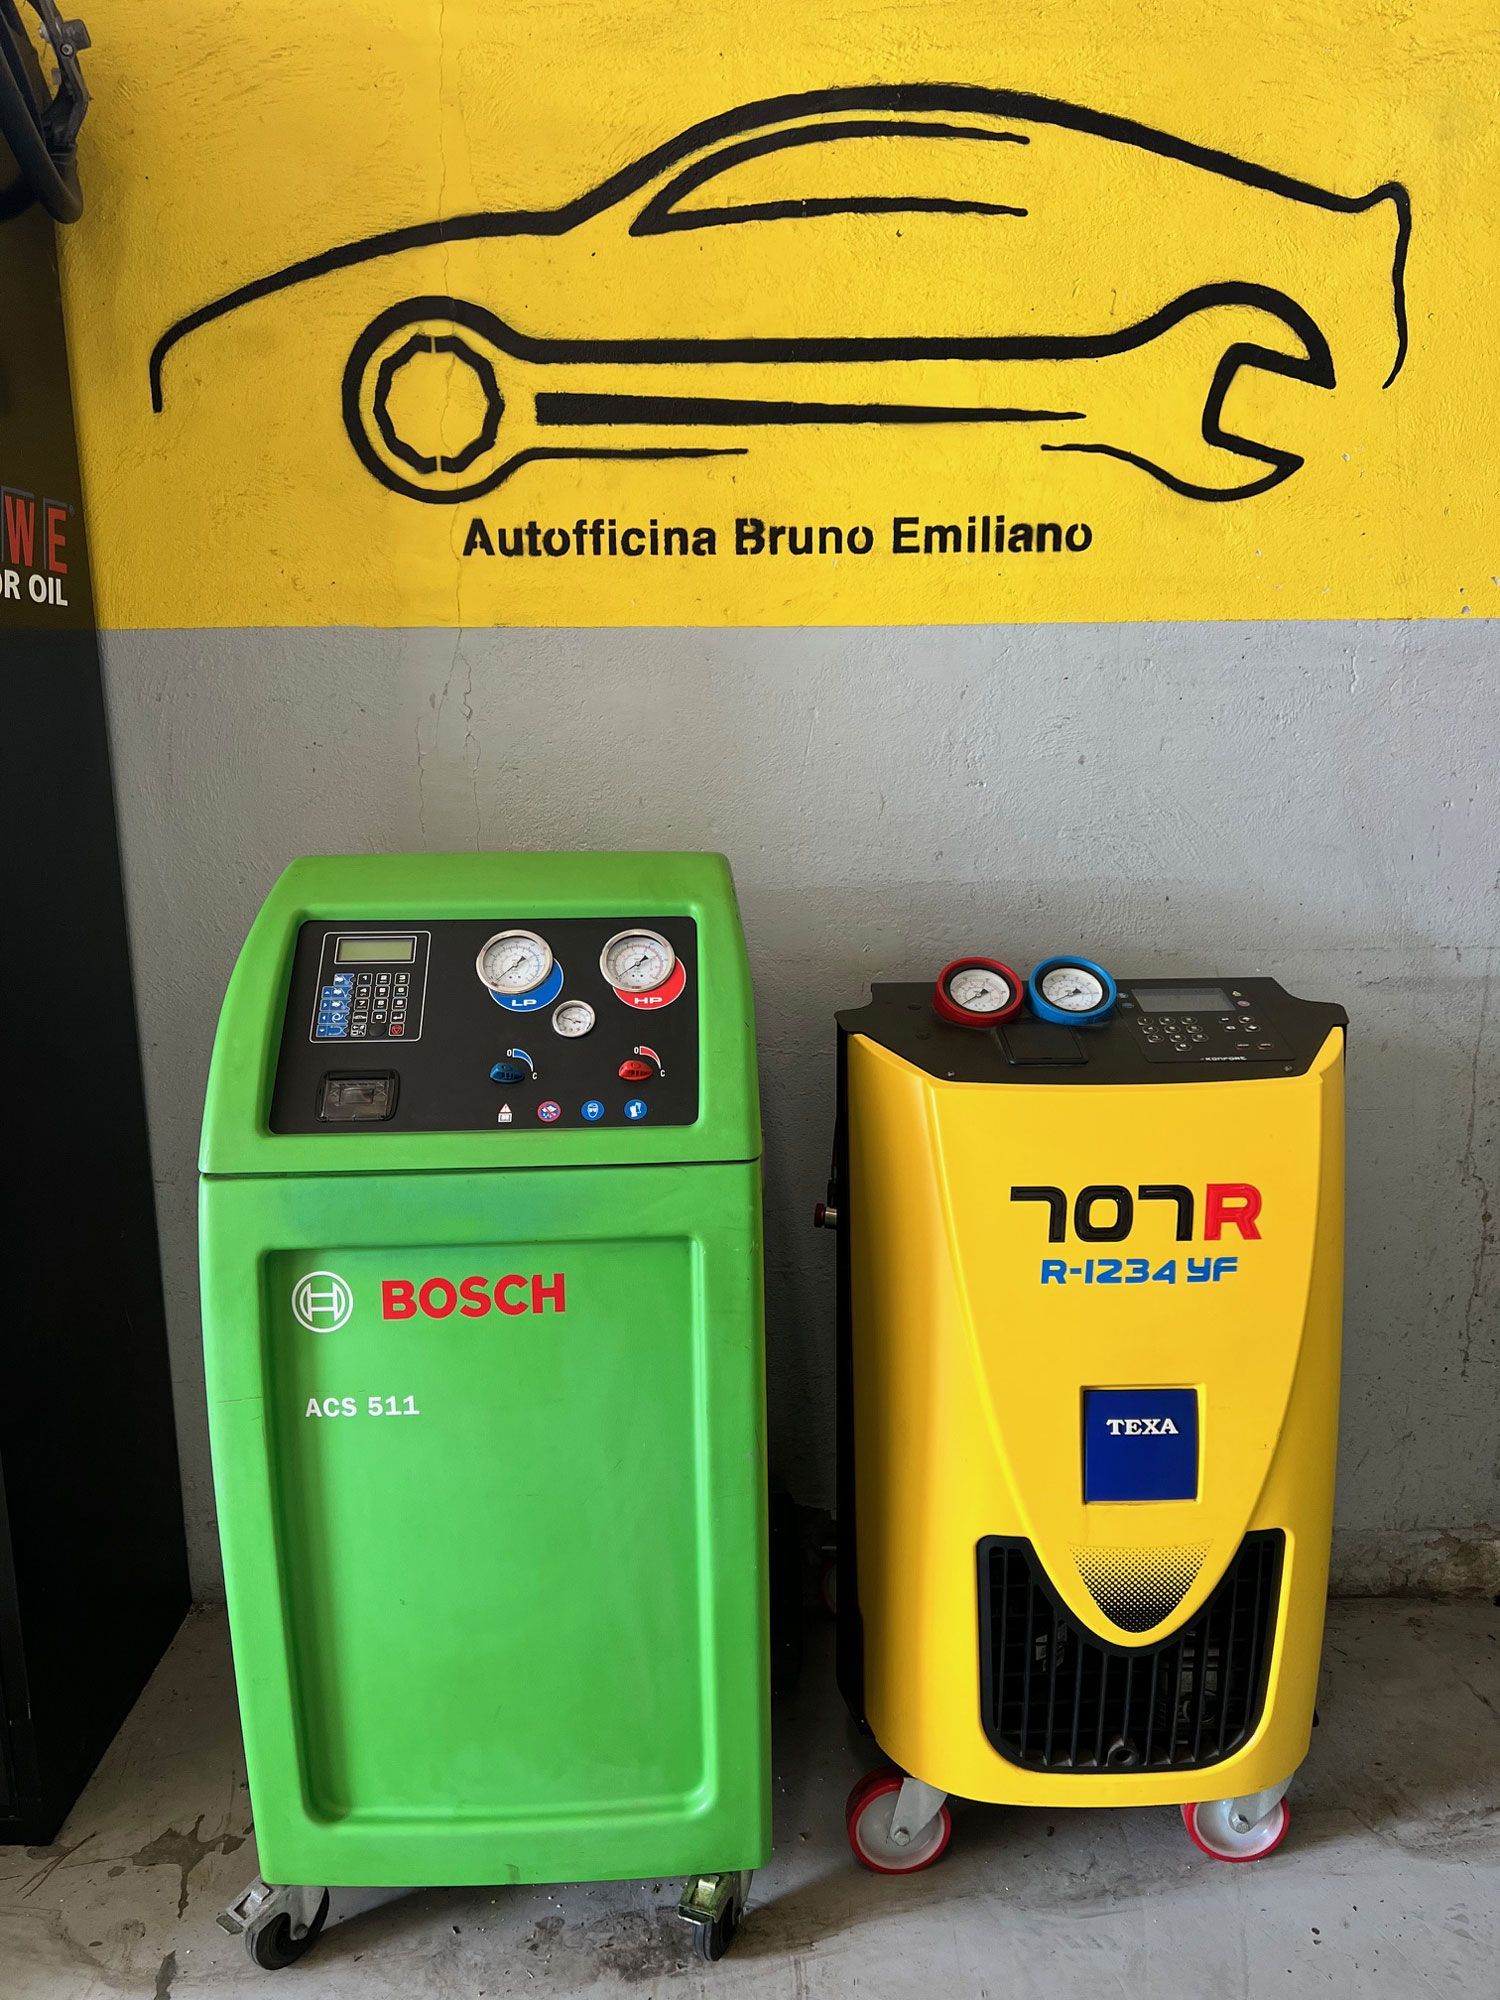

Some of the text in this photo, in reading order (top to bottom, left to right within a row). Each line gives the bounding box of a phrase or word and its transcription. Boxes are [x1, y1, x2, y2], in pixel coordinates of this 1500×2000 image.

[462, 514, 1093, 558] Autofficina Bruno Emiliano
[0, 569, 69, 607] R OIL
[511, 998, 538, 1007] LP
[633, 996, 663, 1005] HP
[531, 1072, 538, 1080] C
[660, 1069, 666, 1078] C
[1010, 1183, 1263, 1243] 707R
[1041, 1256, 1238, 1285] R-1234 YF
[381, 1273, 566, 1321] BOSCH
[305, 1395, 420, 1418] ACS 511
[1105, 1418, 1179, 1436] TEXA
